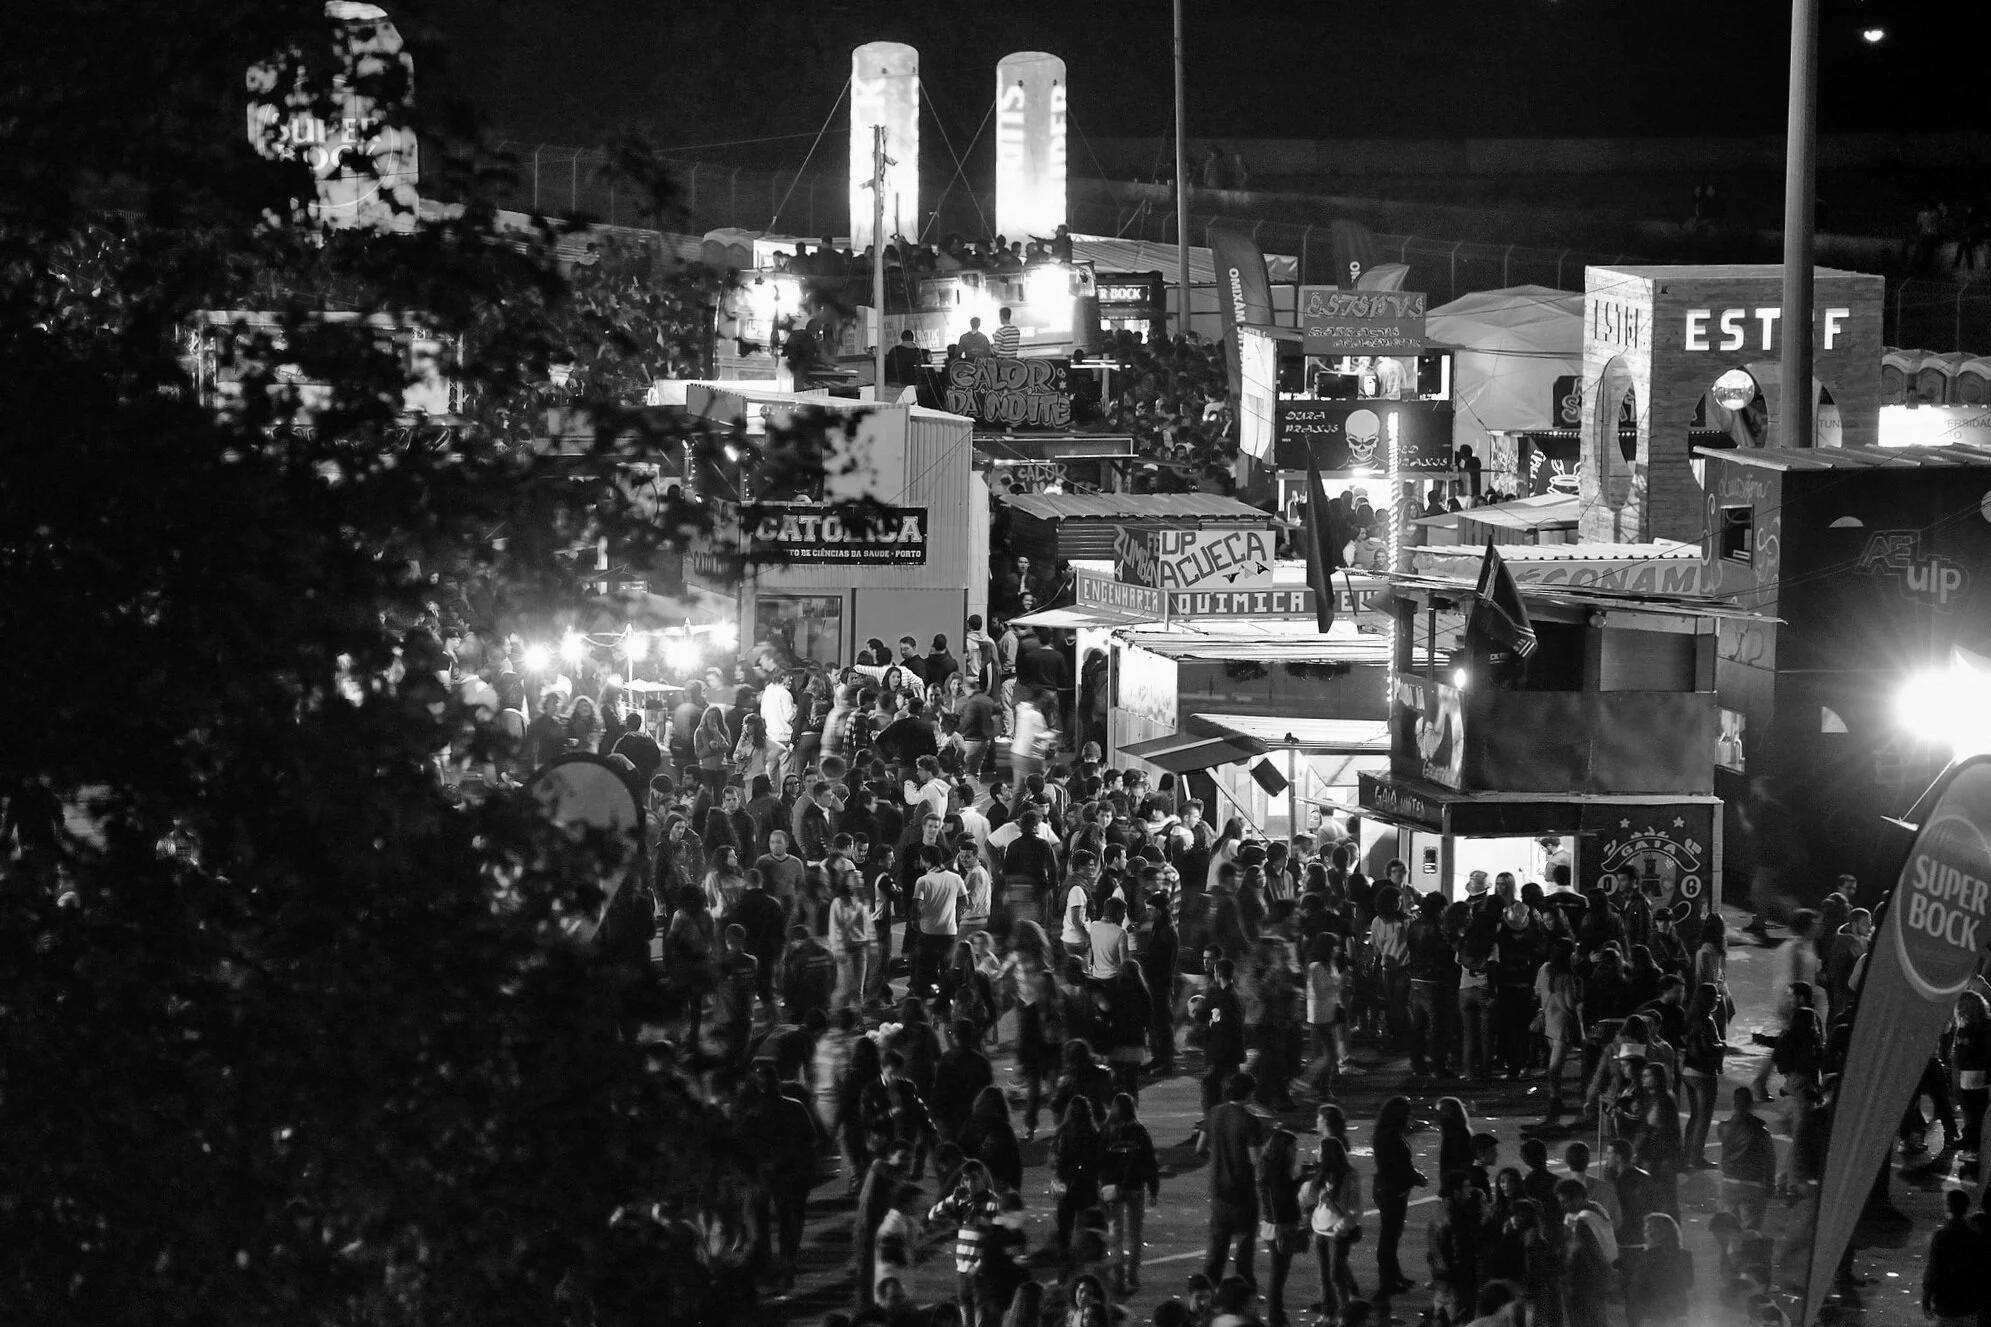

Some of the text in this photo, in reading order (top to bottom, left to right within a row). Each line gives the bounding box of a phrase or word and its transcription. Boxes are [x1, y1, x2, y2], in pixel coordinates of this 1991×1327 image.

[1110, 288, 1141, 300] BOCK
[1685, 307, 1850, 351] ESTF
[950, 357, 1055, 391] CALOR
[851, 549, 862, 557] DA
[895, 549, 922, 558] PORTO
[1083, 578, 1158, 613] ENGENHARIA
[1621, 840, 1677, 857] GAIA
[1912, 855, 1989, 917] SUPER
[1908, 893, 1981, 953] BOCK
